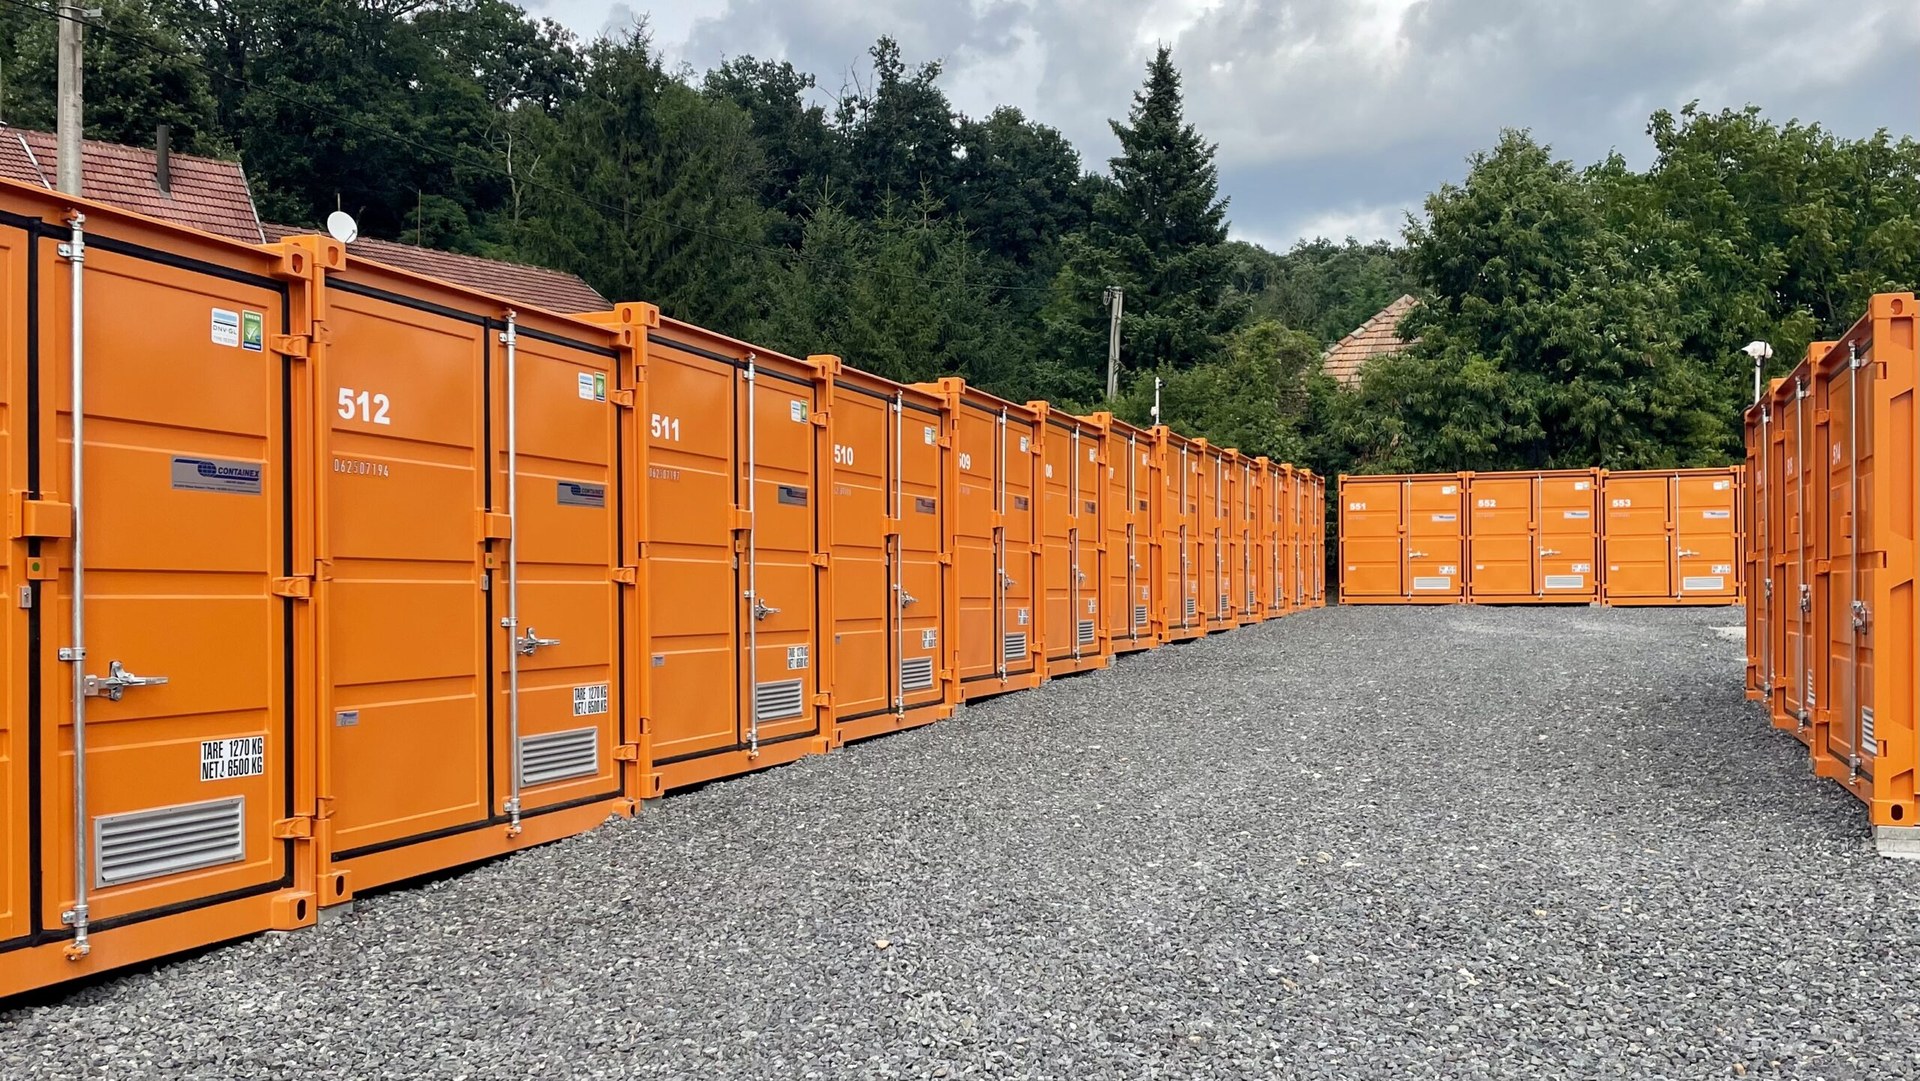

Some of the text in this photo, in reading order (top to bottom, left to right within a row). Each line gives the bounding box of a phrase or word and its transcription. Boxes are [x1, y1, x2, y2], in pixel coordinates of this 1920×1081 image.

[337, 387, 391, 425] 512
[651, 413, 680, 442] 511
[834, 444, 854, 466] 510
[217, 466, 260, 478] CONTAINEX
[1349, 502, 1366, 511] 551
[202, 737, 263, 760] TARE 1270 KG
[228, 757, 250, 777] 6500
[251, 756, 263, 774] KG
